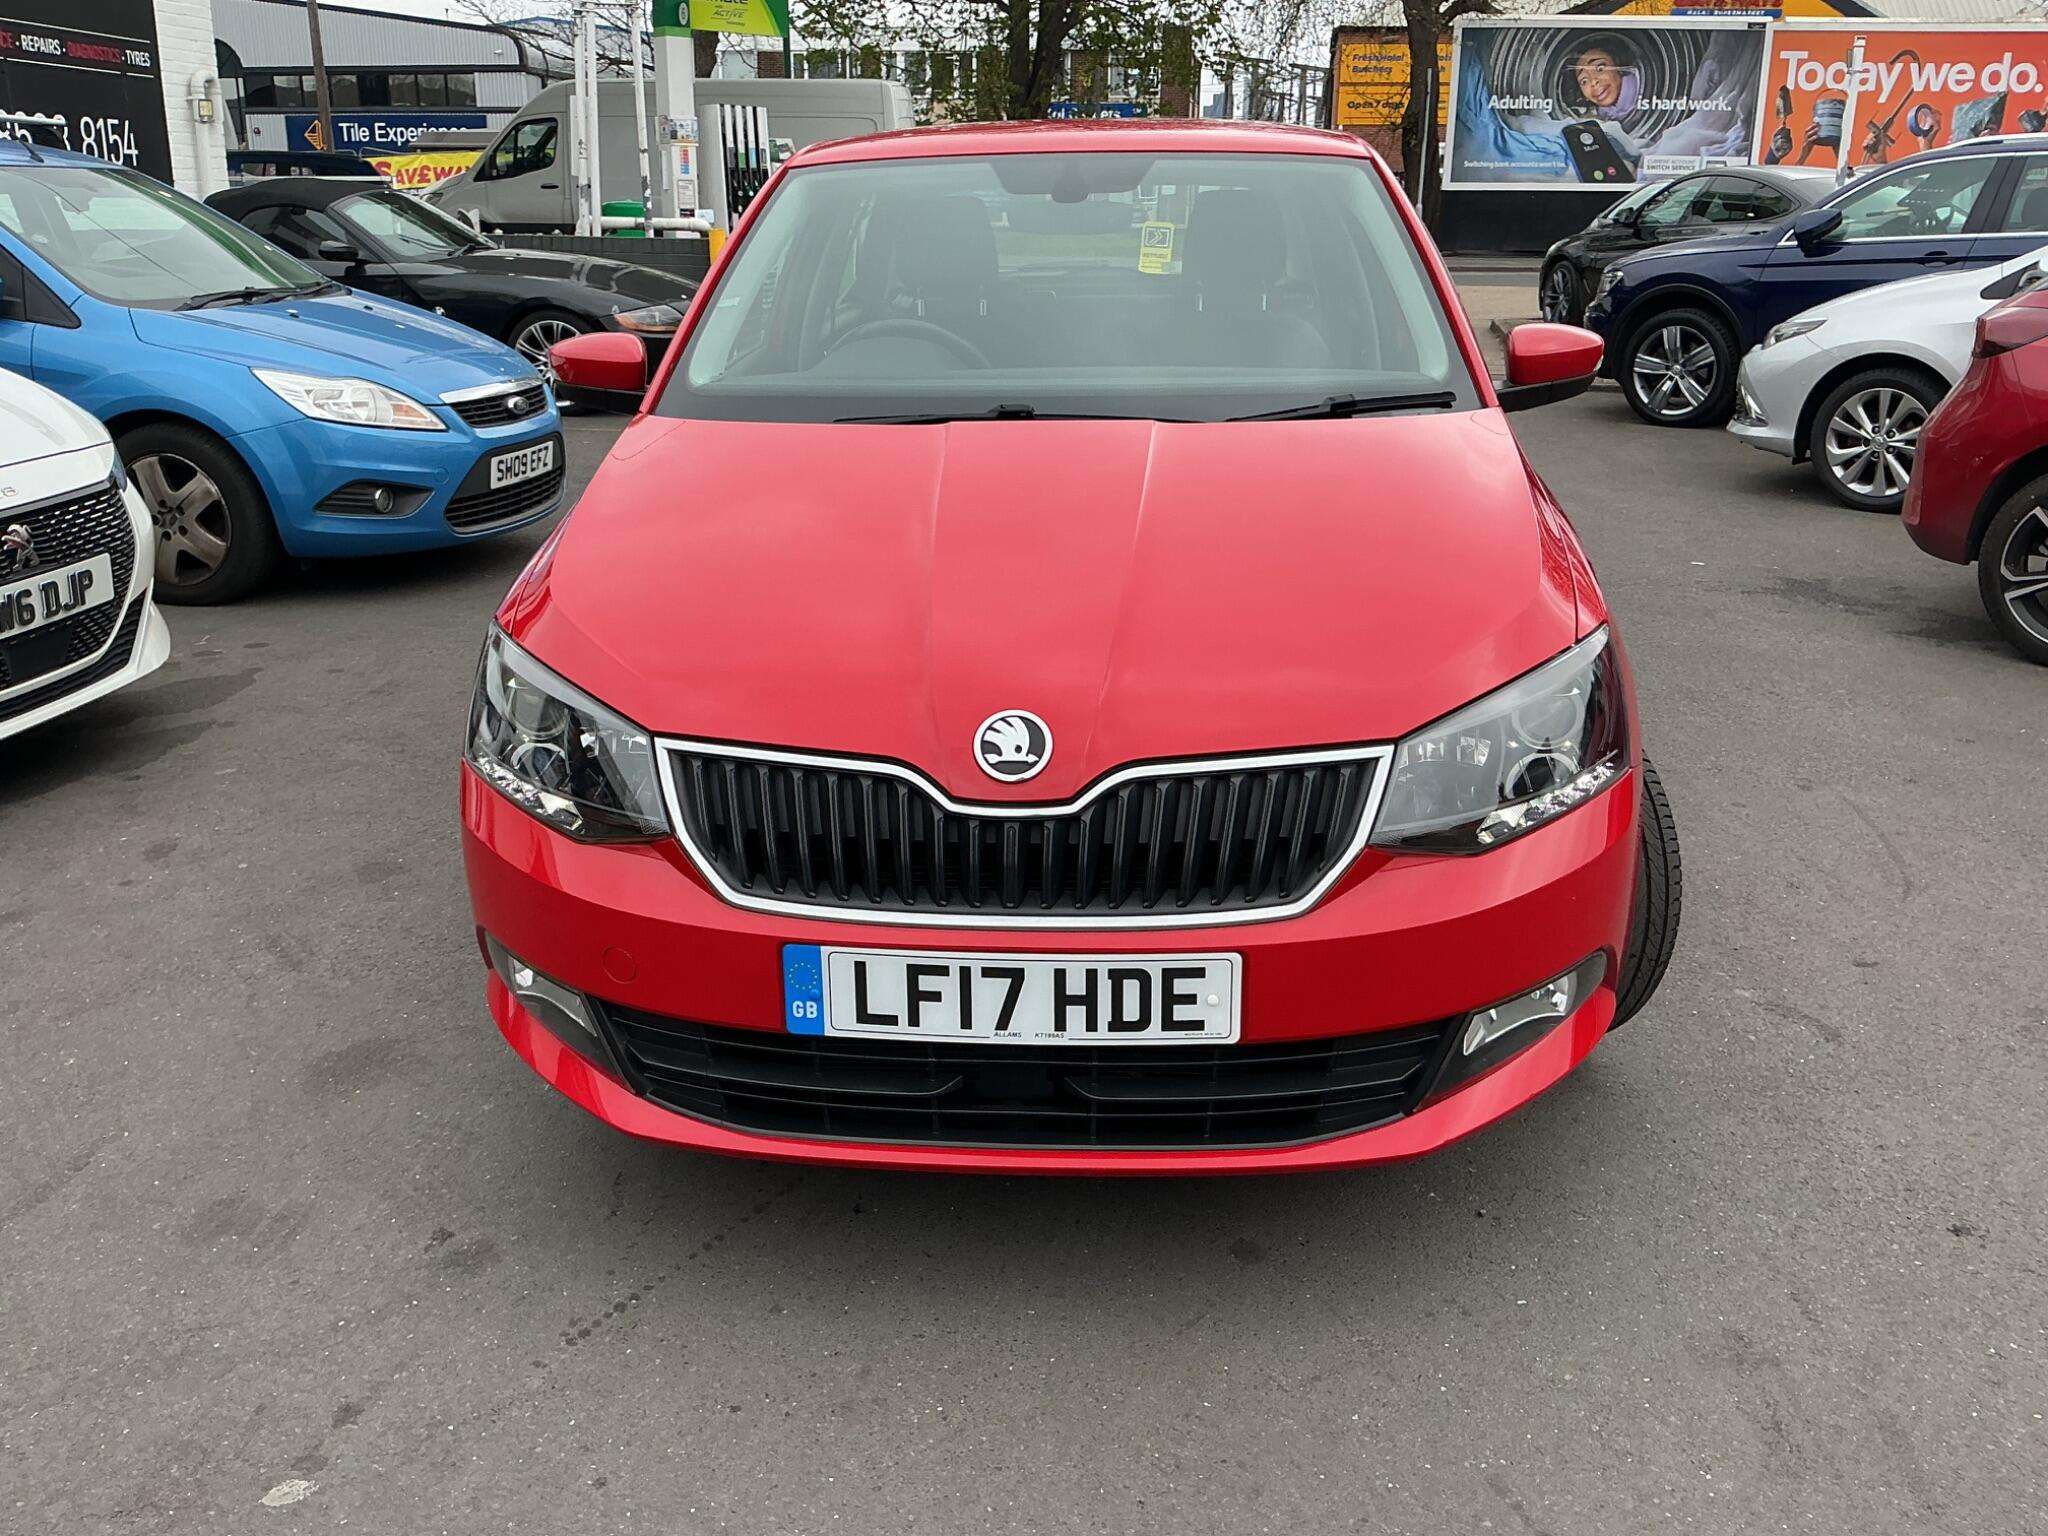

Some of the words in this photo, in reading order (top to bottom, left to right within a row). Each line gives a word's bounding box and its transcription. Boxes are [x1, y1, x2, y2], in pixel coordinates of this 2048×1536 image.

[20, 34, 61, 55] REPAIRS
[125, 50, 151, 67] TYRES
[1909, 62, 1976, 93] we
[1980, 52, 2044, 93] do.
[1488, 95, 1553, 113] Adulting
[1637, 96, 1650, 110] is
[1651, 96, 1686, 111] hard
[1686, 97, 1732, 112] work.
[80, 116, 139, 167] 8154
[338, 122, 370, 142] Tile
[497, 453, 528, 482] SH09
[530, 446, 549, 472] EFZ
[38, 569, 94, 619] DJP
[792, 1001, 818, 1019] GB
[854, 960, 1026, 1031] LF17
[1053, 966, 1206, 1032] HDE
